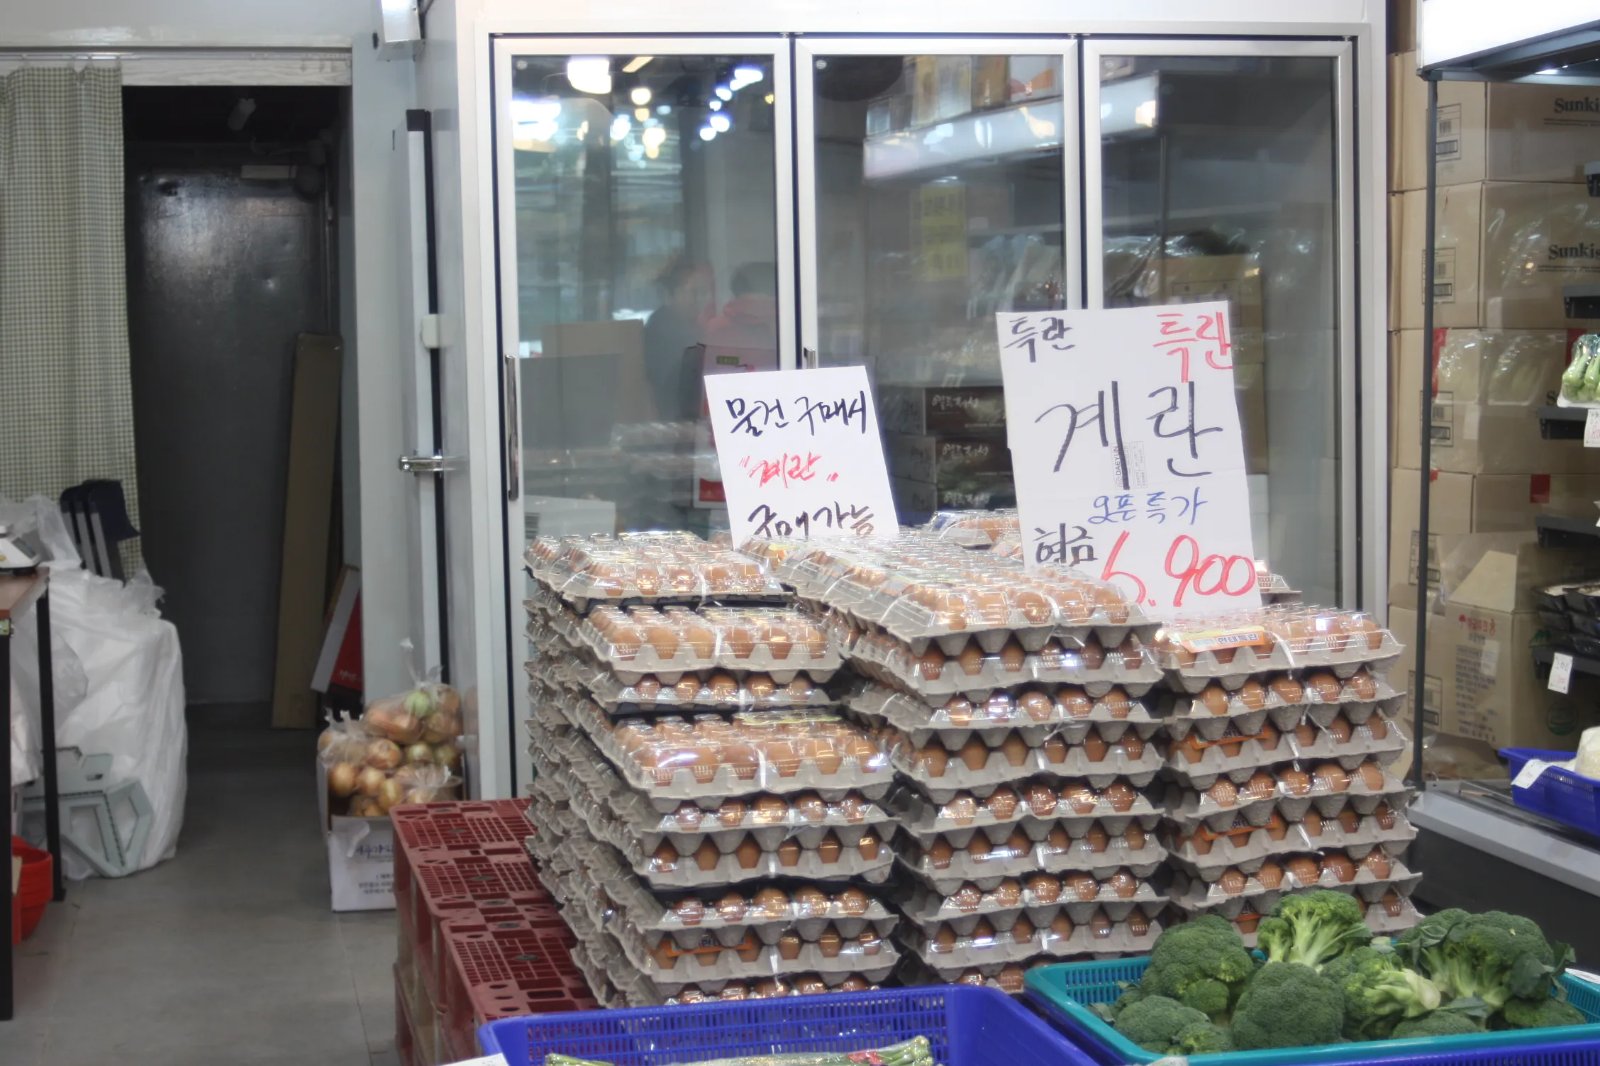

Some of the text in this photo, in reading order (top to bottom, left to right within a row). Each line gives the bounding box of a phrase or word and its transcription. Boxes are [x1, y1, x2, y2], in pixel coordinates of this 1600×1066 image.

[1153, 311, 1233, 383] 특란
[725, 390, 867, 437] 물건 구매시
[1034, 380, 1223, 491] 계란
[1146, 487, 1208, 526] 특가
[1033, 523, 1098, 567] 현금
